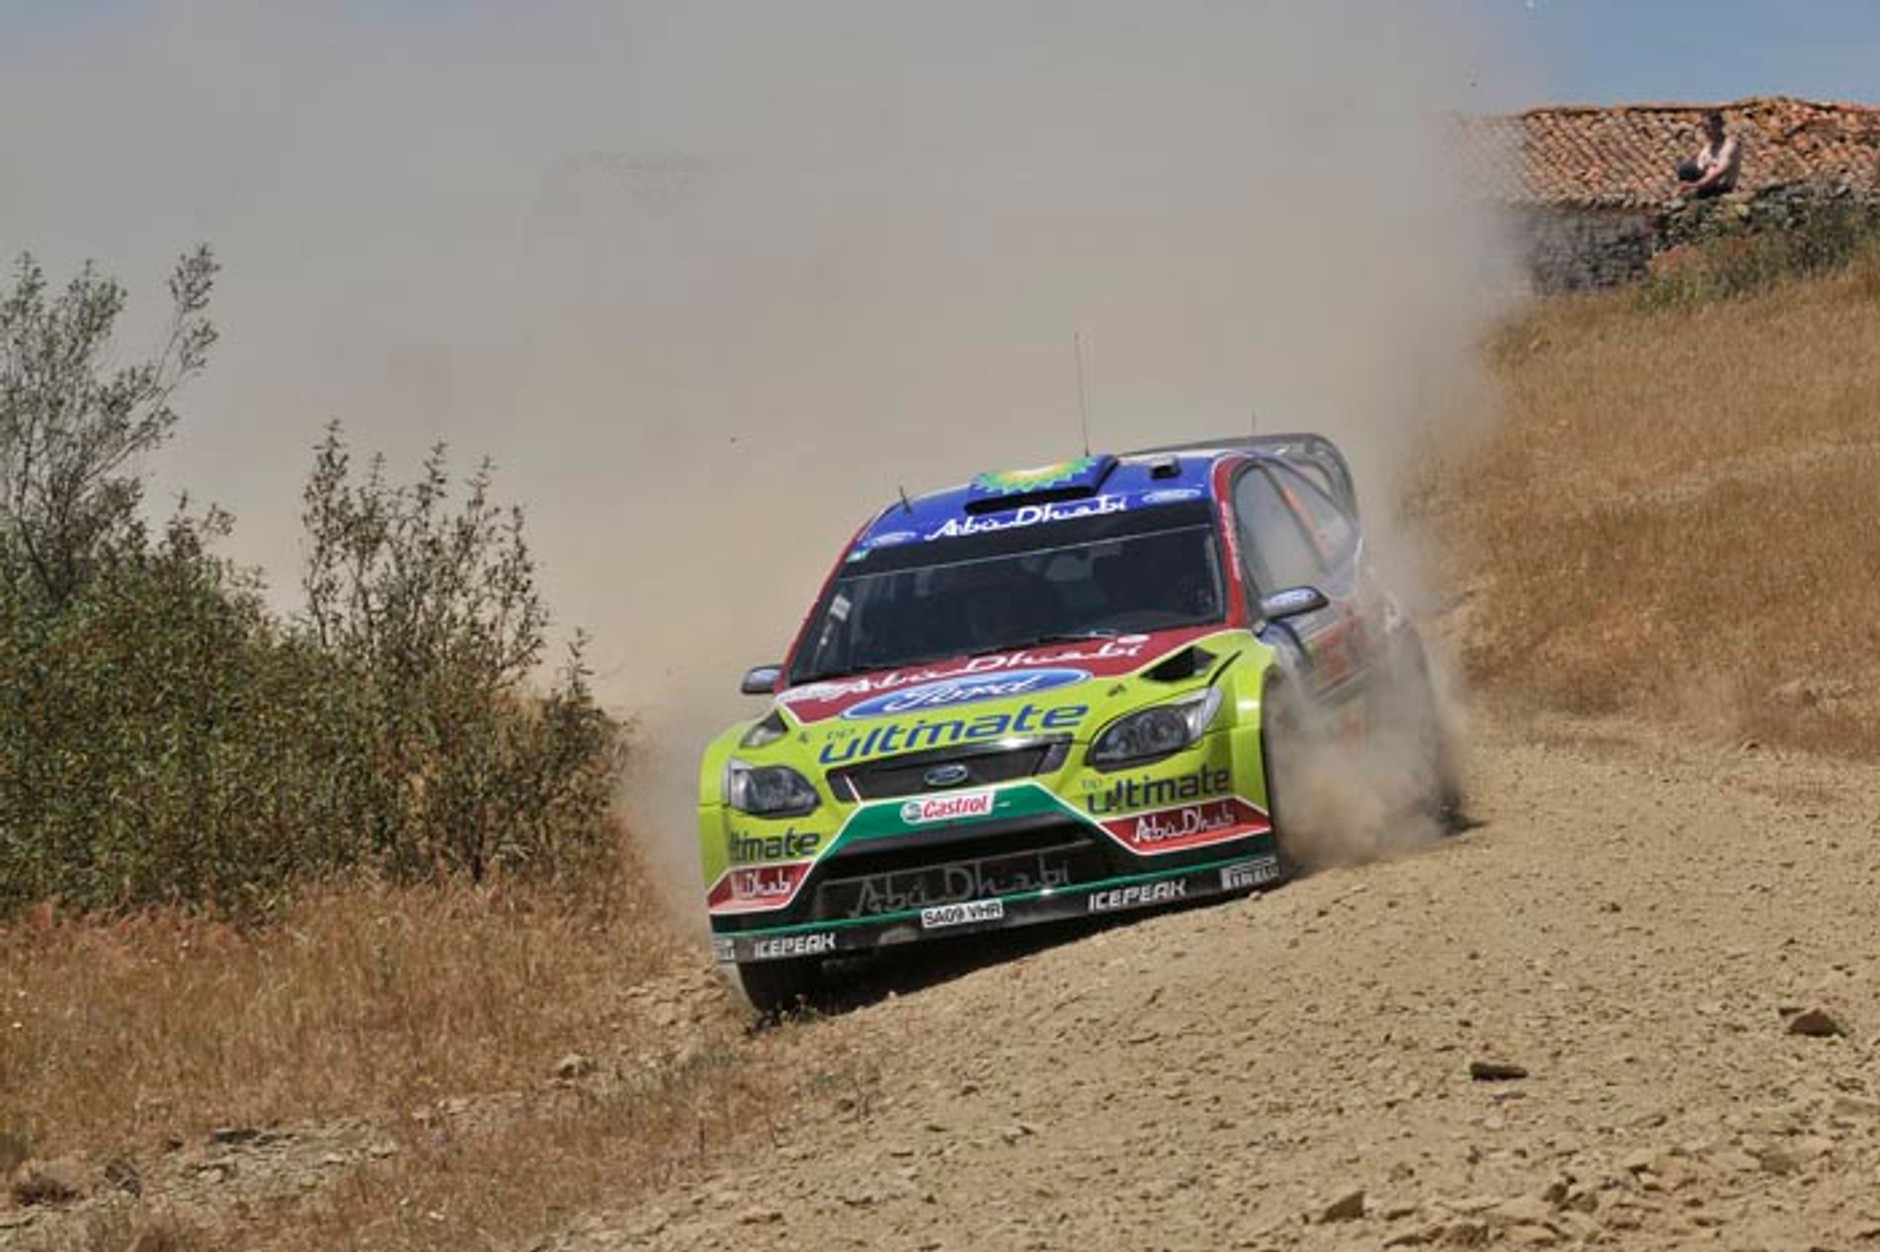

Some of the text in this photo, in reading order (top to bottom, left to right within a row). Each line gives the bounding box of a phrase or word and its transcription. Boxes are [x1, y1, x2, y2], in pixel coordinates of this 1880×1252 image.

[924, 517, 1004, 541] Abu
[1010, 494, 1127, 528] Dhabi
[882, 674, 1047, 713] Ford
[818, 703, 1089, 765] ultimate
[922, 794, 989, 819] Castrol
[1087, 763, 1230, 814] ultimate
[1131, 814, 1180, 843] Abu
[849, 852, 1070, 919] Abu Dhabi
[1087, 879, 1188, 912] ICEPEAK
[924, 904, 1002, 926] SA09 VHR
[754, 932, 837, 960] ICEPEAK
